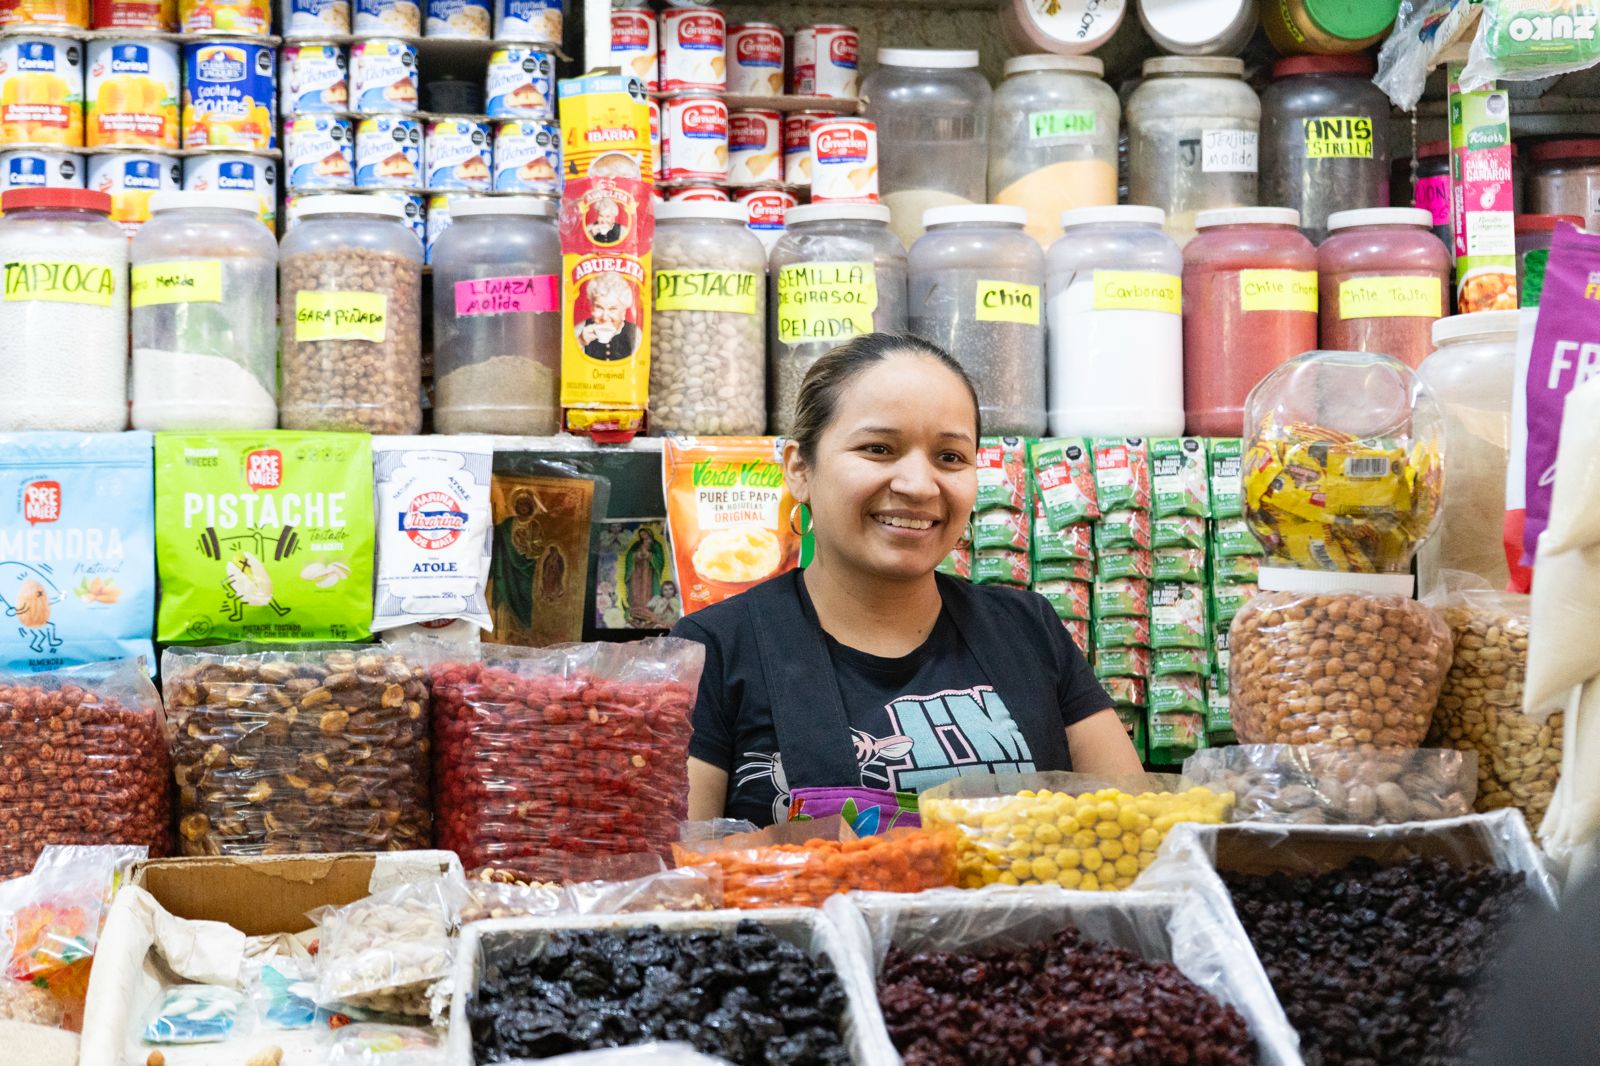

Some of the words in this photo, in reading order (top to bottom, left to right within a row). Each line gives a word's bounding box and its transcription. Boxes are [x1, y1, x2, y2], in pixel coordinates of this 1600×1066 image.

[612, 27, 648, 36] rnation
[1509, 15, 1597, 42] ZUKO
[588, 130, 635, 142] IBARRA
[1304, 120, 1371, 140] ANIS
[1469, 131, 1505, 145] Knorr
[1306, 140, 1372, 156] STRELLA
[576, 257, 644, 282] ABUELITA
[778, 265, 863, 289] SEMILLA
[5, 262, 114, 295] TAPIOCA
[657, 270, 755, 299] PISTACHE
[1244, 281, 1284, 296] Chile
[793, 290, 867, 306] GIRASOL
[983, 289, 1033, 309] Chia
[781, 317, 853, 338] PELADA
[592, 368, 625, 382] Original
[251, 455, 279, 472] PRE
[693, 457, 737, 488] Verde
[740, 458, 784, 488] Valle
[28, 487, 57, 505] PRE
[700, 491, 728, 503] PURÉ
[732, 491, 746, 502] DE
[749, 491, 778, 502] PAPA
[183, 491, 347, 529] PISTACHE
[714, 511, 766, 523] ORIGINAL
[0, 528, 124, 561] MENDRA
[414, 534, 429, 547] DE
[412, 562, 457, 573] ATOLE
